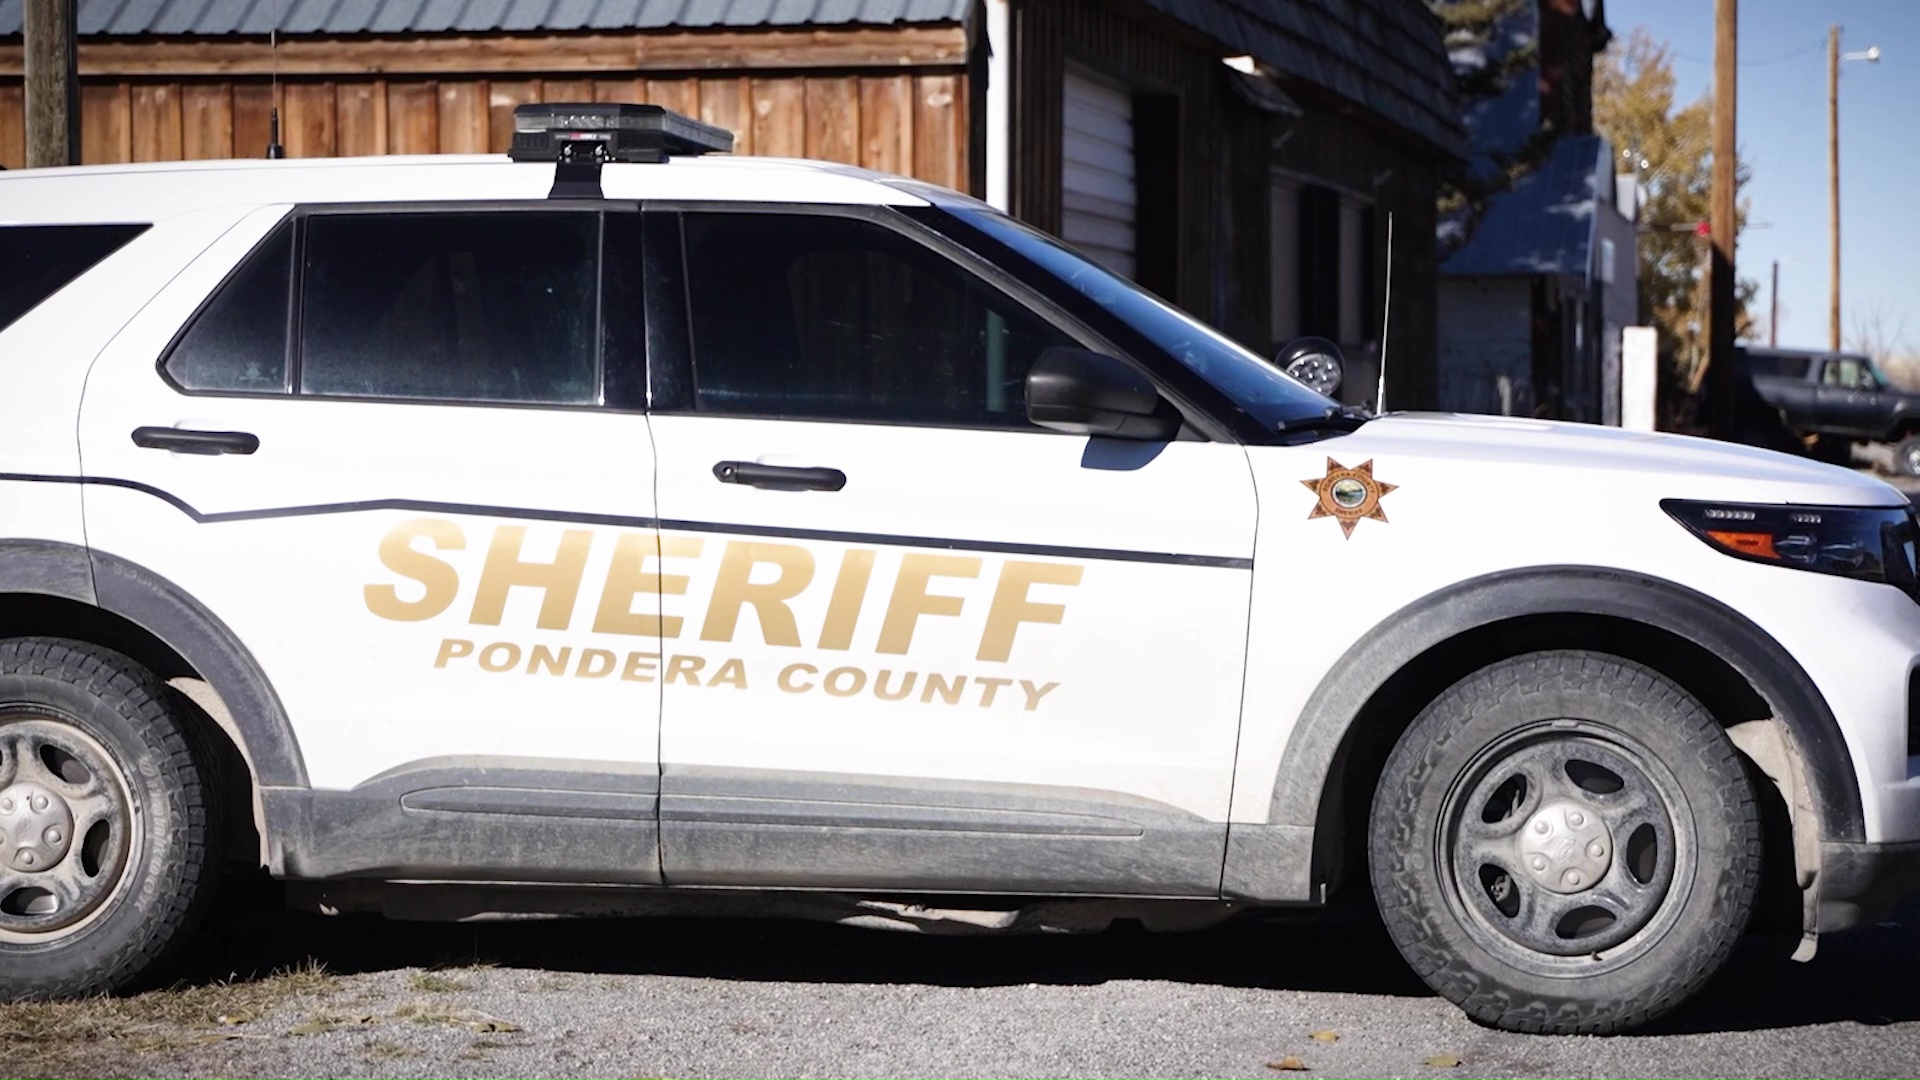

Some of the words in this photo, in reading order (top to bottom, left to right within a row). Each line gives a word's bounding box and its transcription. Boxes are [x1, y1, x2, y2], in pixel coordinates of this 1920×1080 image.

[363, 517, 1085, 662] SHERIFF
[434, 638, 748, 690] PONDERA
[776, 663, 1061, 711] COUNTY
